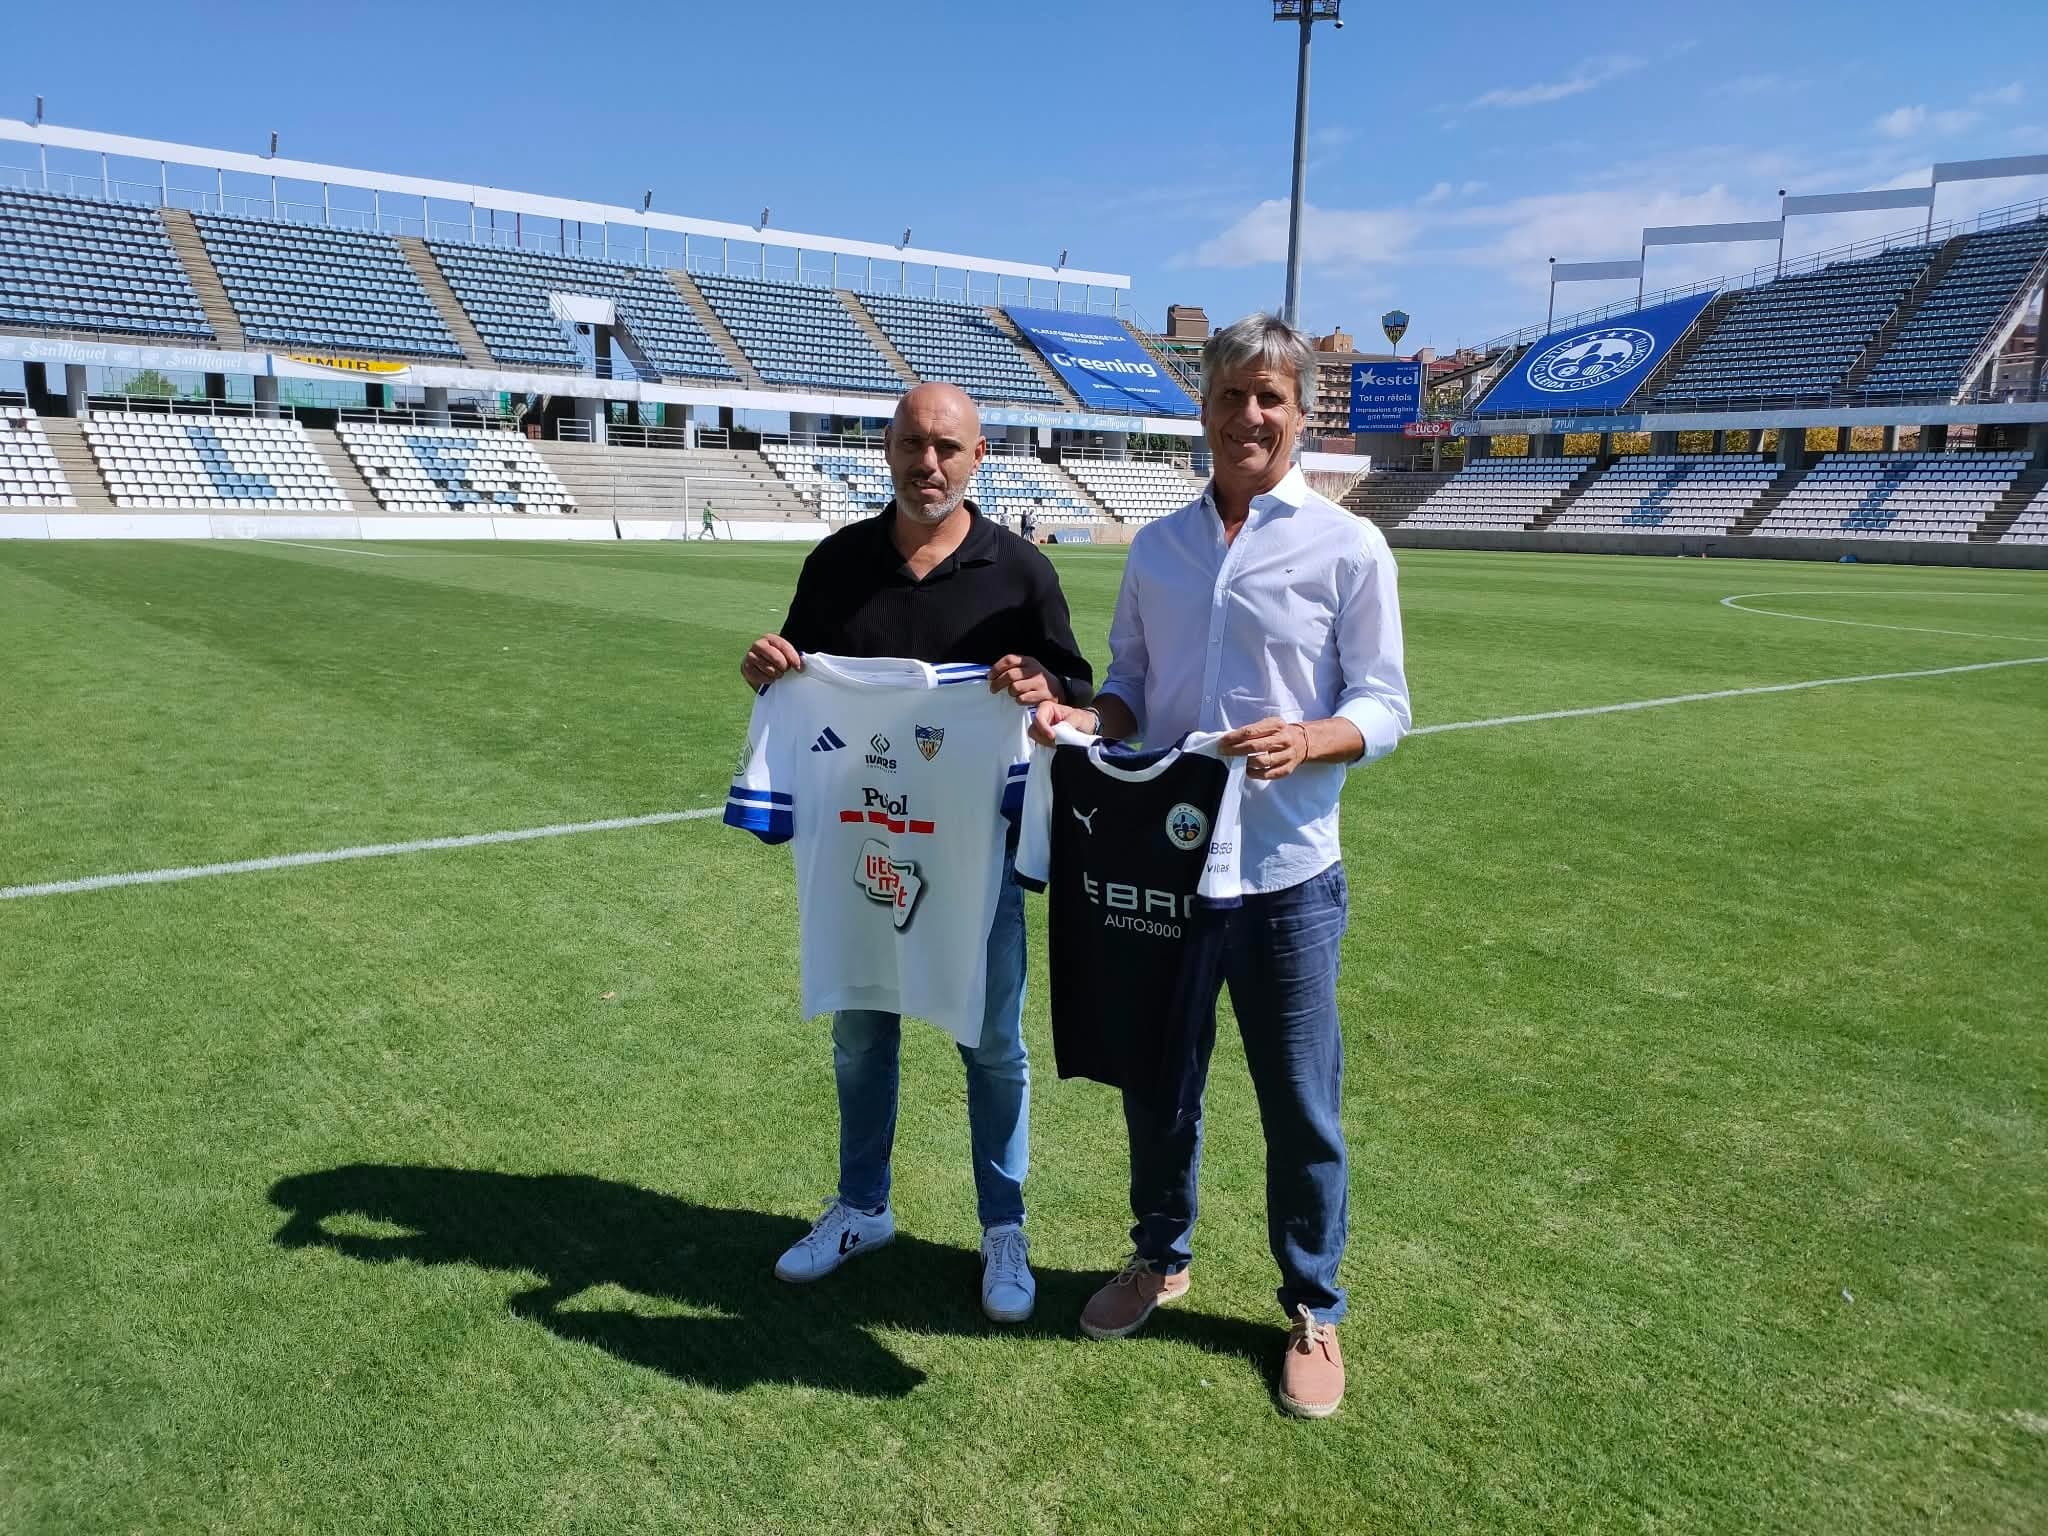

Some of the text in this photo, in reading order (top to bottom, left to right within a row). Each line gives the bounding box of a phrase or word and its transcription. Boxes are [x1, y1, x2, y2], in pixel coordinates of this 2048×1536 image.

[1052, 353, 1157, 378] Greening
[1375, 371, 1418, 386] estel
[1570, 373, 1610, 388] CLUB
[1359, 394, 1374, 402] Tot
[1063, 535, 1091, 543] LLEIDA
[865, 754, 897, 770] IVARS
[1104, 913, 1181, 939] AUTO3000
